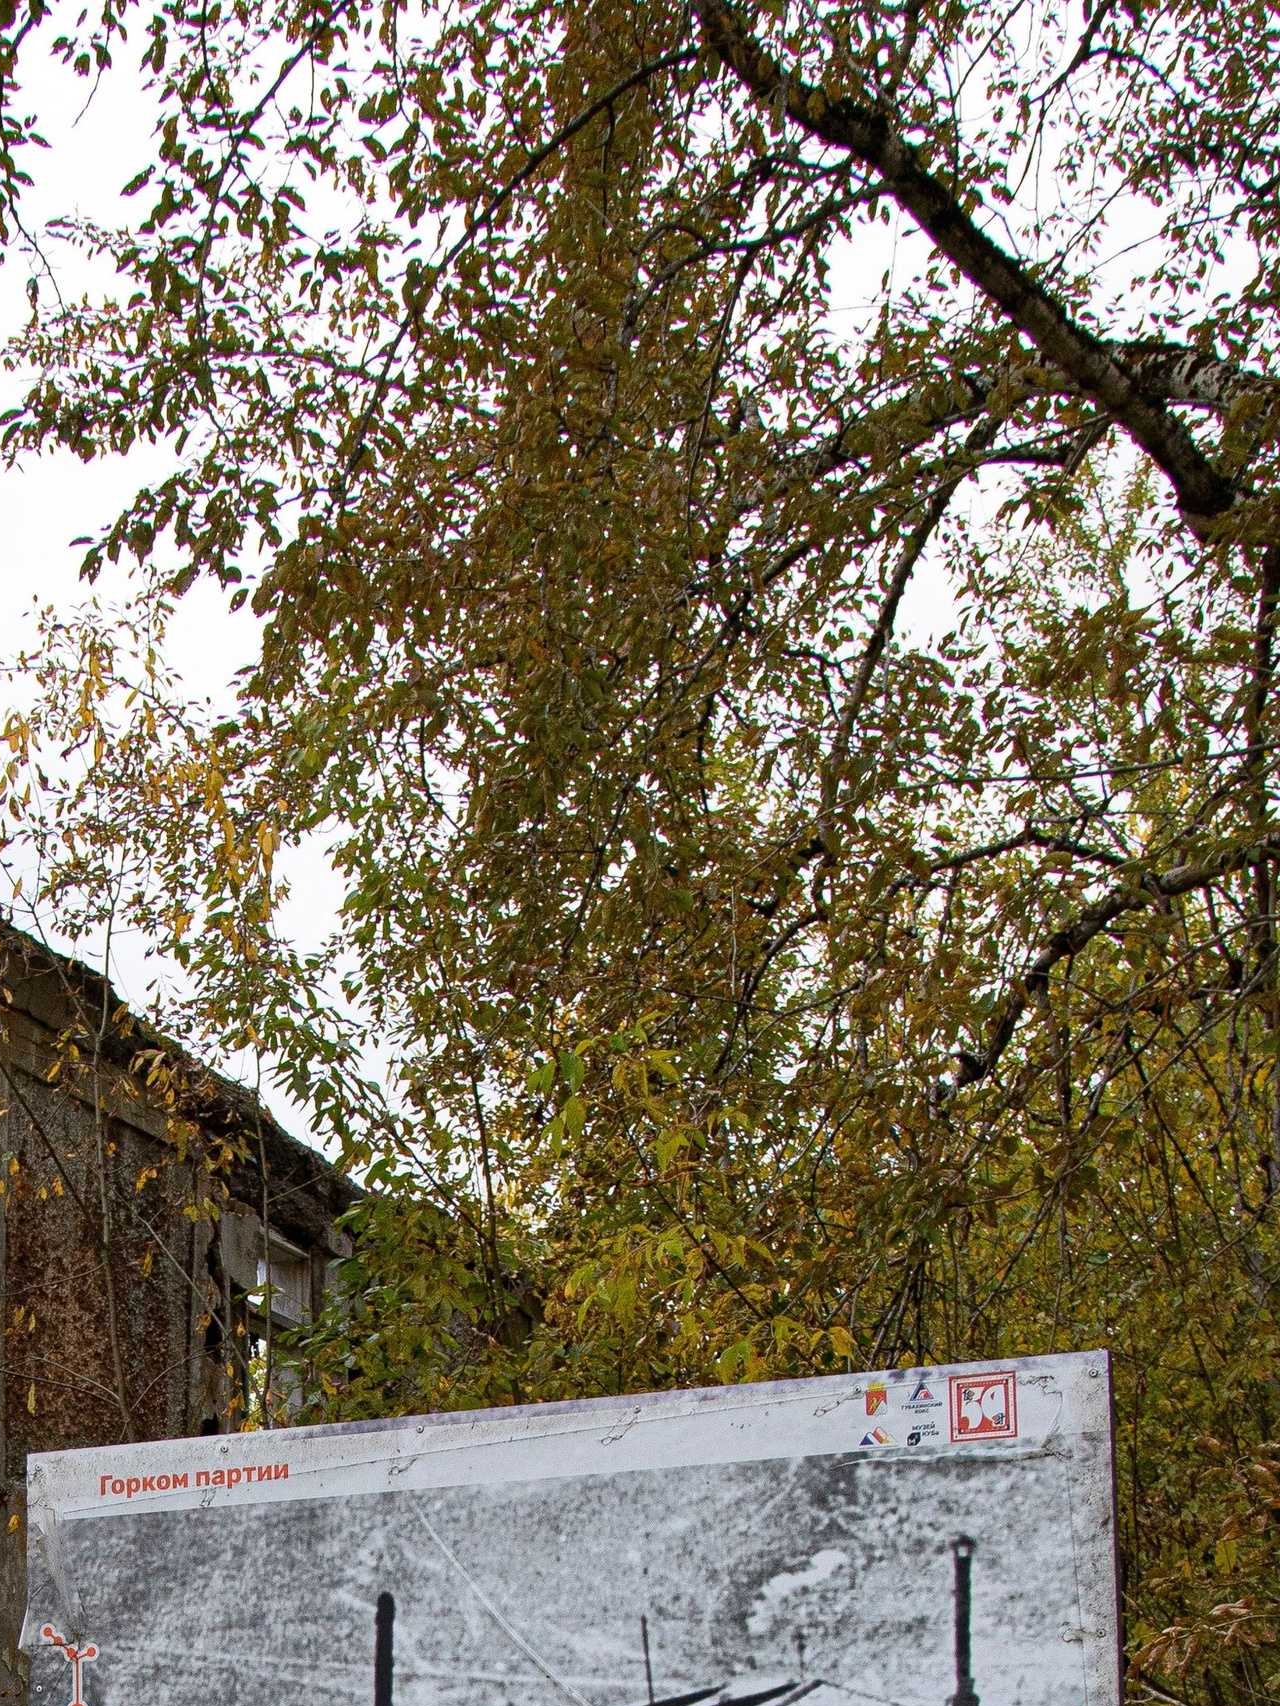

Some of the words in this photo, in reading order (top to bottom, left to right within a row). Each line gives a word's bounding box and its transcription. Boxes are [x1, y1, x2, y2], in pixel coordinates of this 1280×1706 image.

[901, 1401, 943, 1410] ГУБАХИНСКИЙ
[912, 1421, 936, 1431] МУЗЕЙ
[100, 1473, 189, 1499] Горком
[196, 1463, 290, 1489] партии
